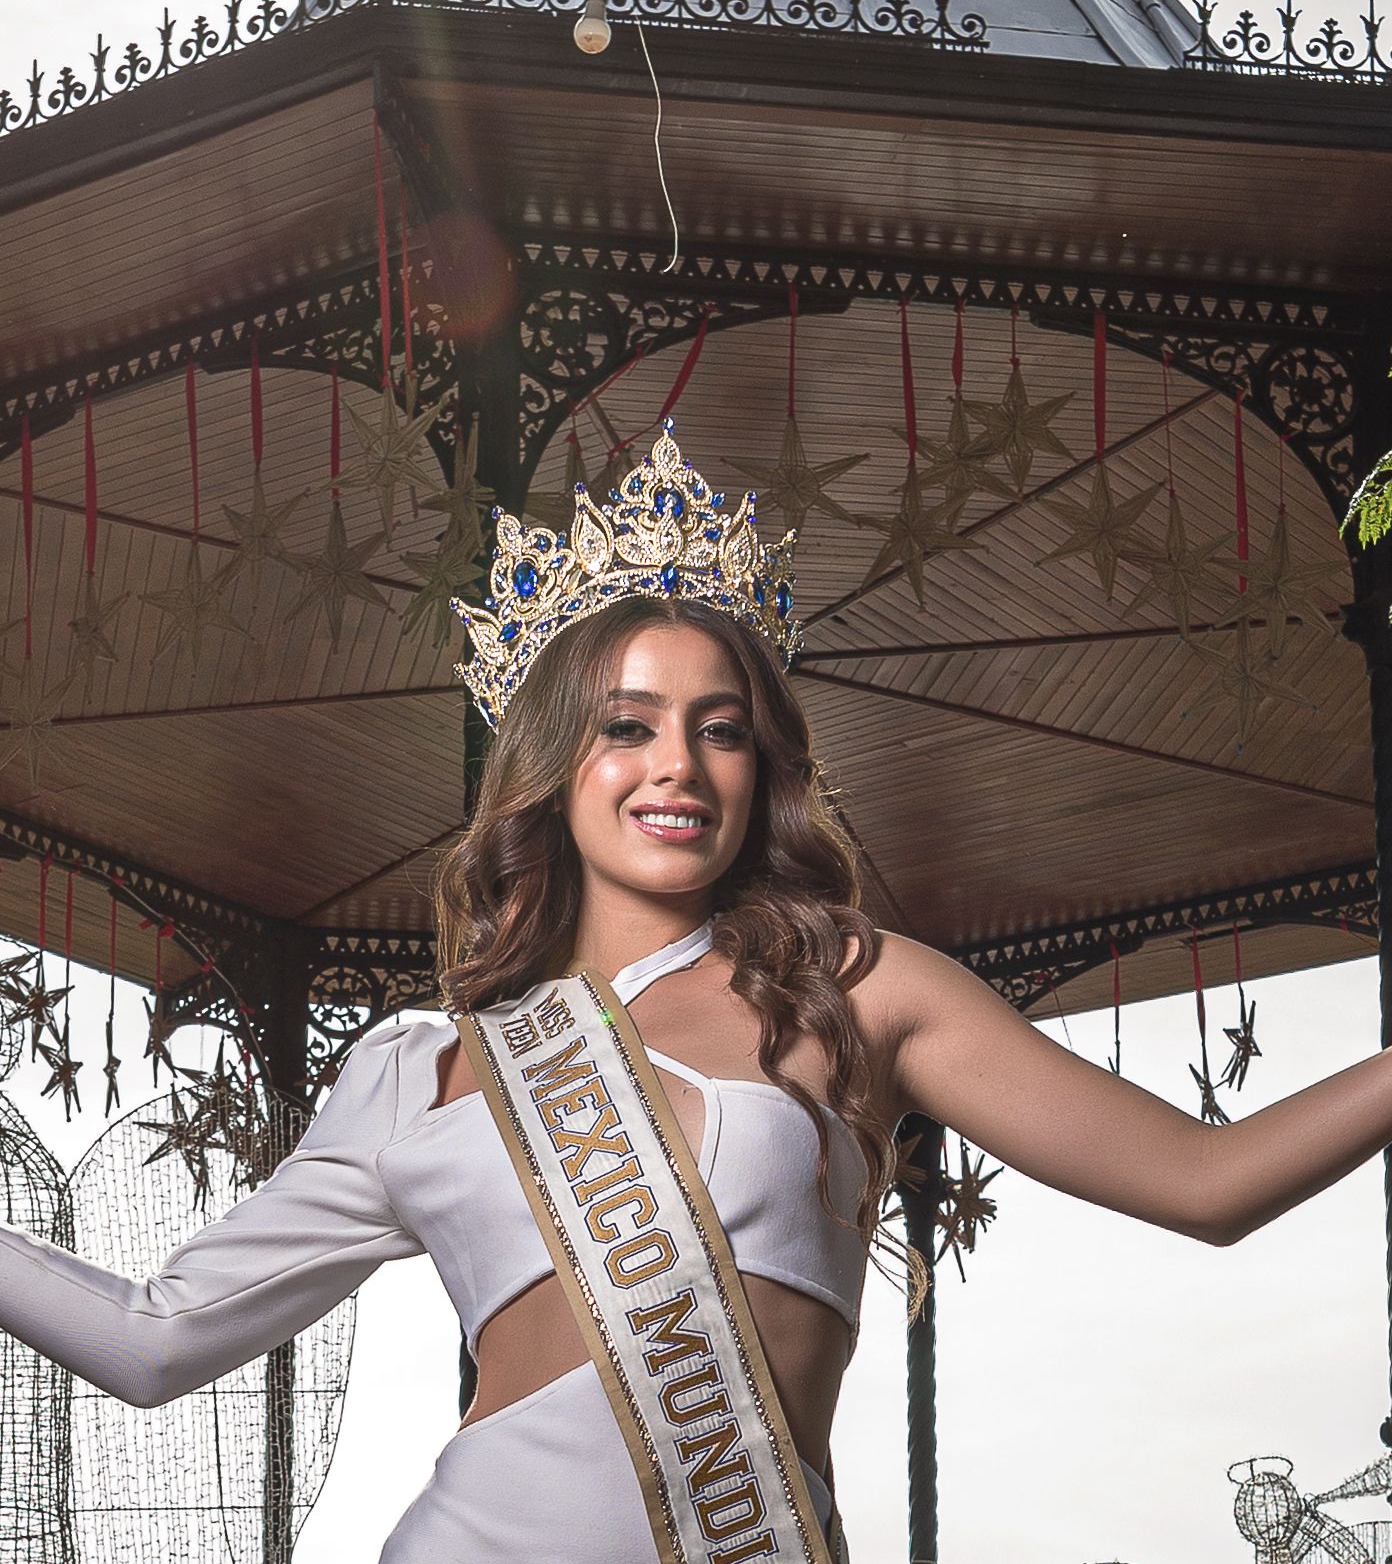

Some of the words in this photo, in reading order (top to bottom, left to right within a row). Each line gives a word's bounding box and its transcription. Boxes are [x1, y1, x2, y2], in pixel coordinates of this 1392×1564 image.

[499, 1013, 543, 1059] TEEN
[533, 986, 576, 1040] MISS
[521, 1035, 679, 1289] MEXICO
